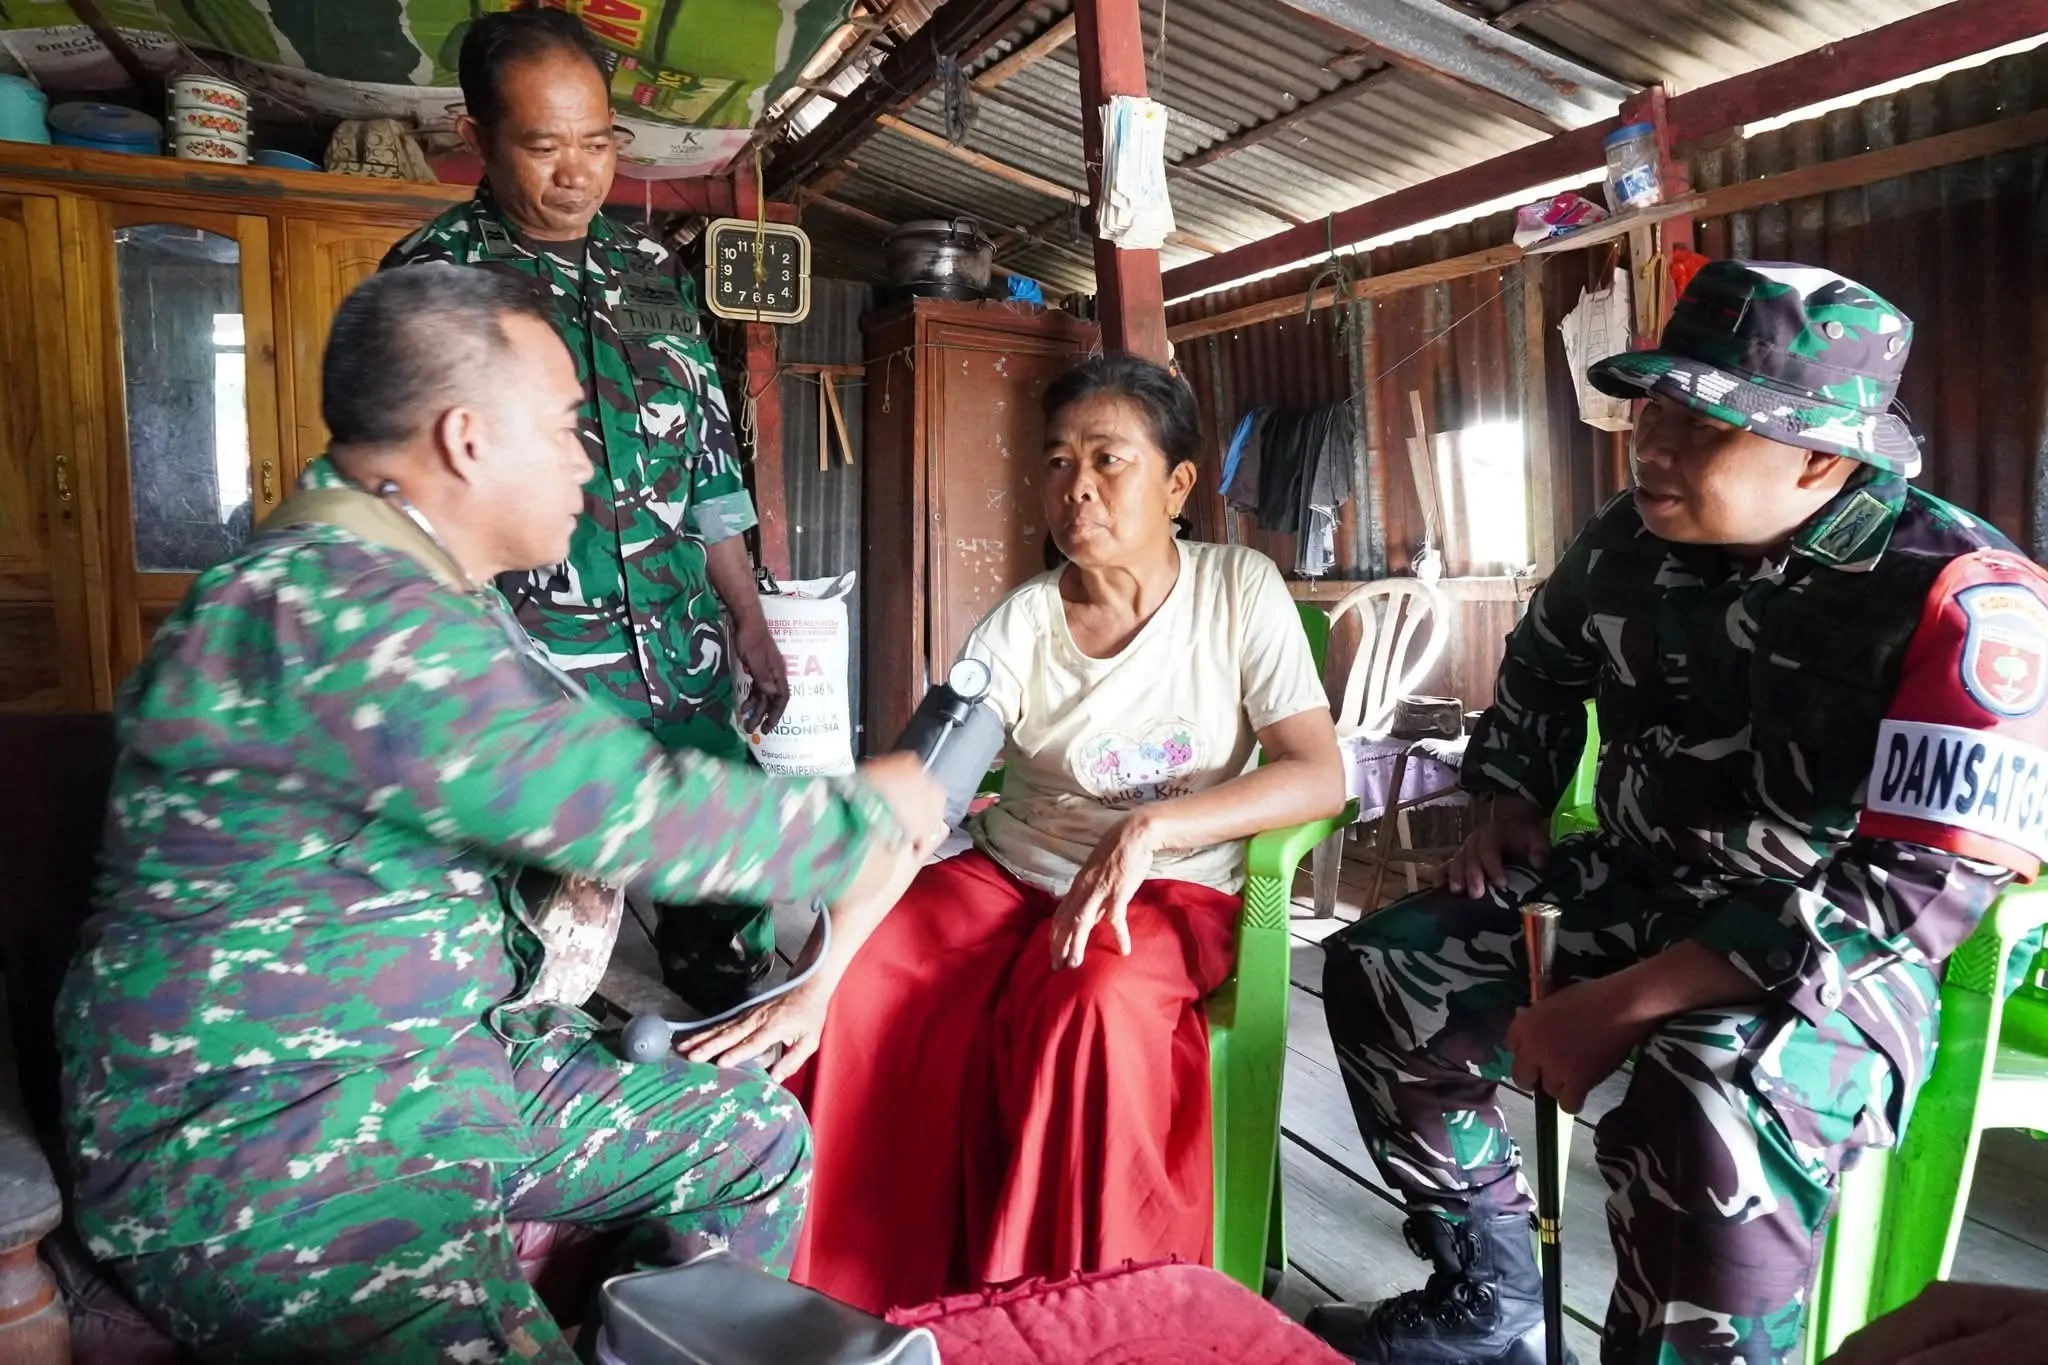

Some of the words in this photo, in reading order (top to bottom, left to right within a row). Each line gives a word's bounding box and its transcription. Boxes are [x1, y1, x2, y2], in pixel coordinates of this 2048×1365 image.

[737, 240, 748, 253] 11
[769, 244, 776, 256] 1
[724, 247, 737, 260] 10
[782, 253, 790, 265] 2
[723, 264, 733, 276] 9
[781, 270, 790, 281] 3
[723, 281, 733, 293] 8
[781, 287, 790, 298] 4
[738, 290, 747, 302] 7
[752, 292, 761, 303] 6
[767, 293, 776, 305] 5
[622, 308, 662, 330] TNI
[670, 313, 693, 333] AD
[784, 654, 824, 676] EA
[782, 711, 840, 725] UPUK
[769, 722, 840, 736] NDONESIA
[1097, 785, 1145, 806] Hello
